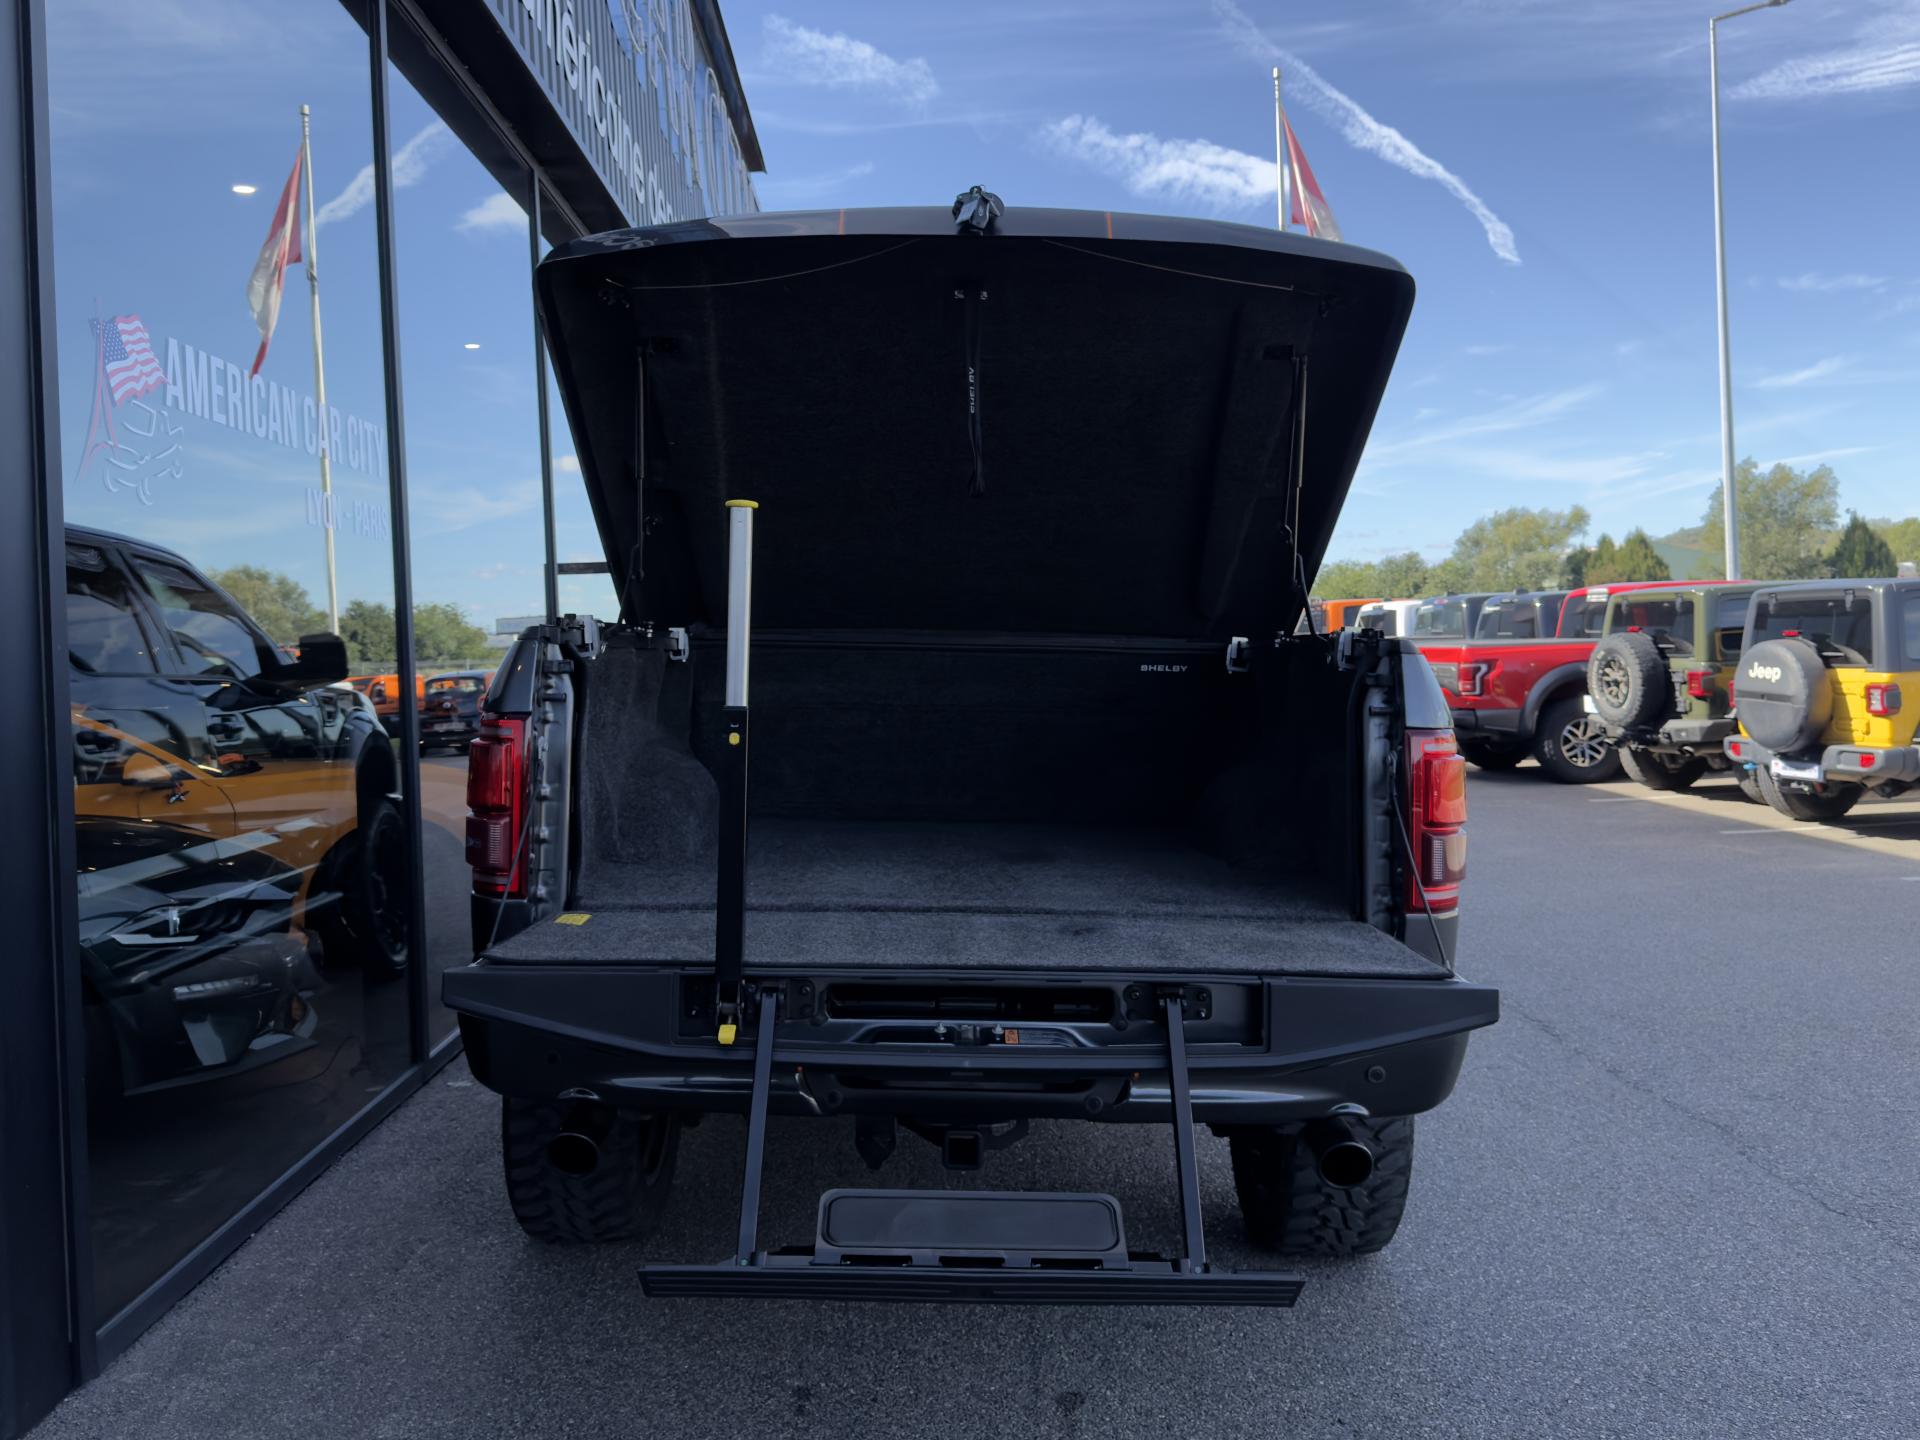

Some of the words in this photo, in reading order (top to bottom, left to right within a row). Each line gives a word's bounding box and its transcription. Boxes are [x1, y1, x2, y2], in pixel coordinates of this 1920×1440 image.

[166, 337, 298, 448] AMERICAN
[304, 395, 344, 464] CAR
[347, 416, 386, 477] CITY
[306, 487, 342, 531] LYON
[354, 499, 388, 540] PARIS
[1140, 664, 1188, 672] SHELBY
[1748, 661, 1782, 683] Jeep
